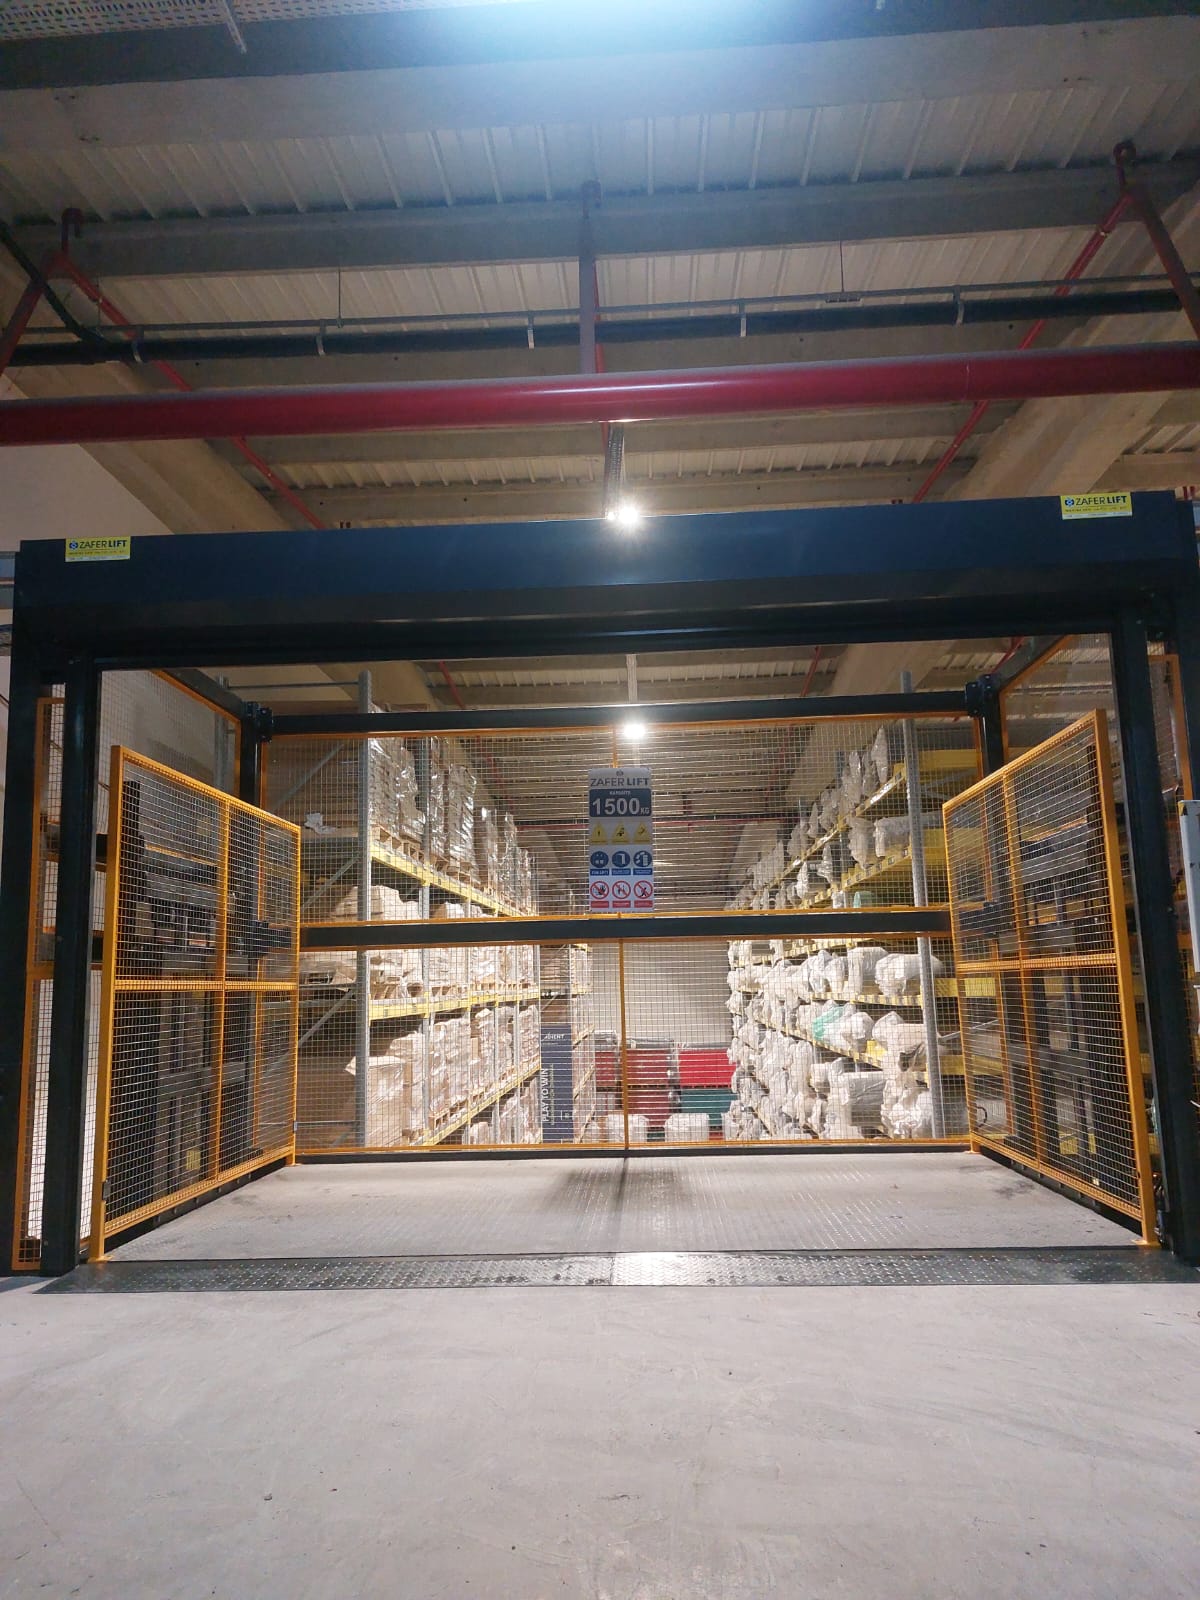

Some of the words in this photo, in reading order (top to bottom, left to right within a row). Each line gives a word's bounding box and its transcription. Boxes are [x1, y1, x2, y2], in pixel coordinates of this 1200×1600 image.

[591, 777, 625, 787] ZAFER
[627, 777, 649, 786] LIFT
[592, 798, 640, 815] 1500
[541, 1068, 549, 1087] WIN
[541, 1088, 549, 1100] TO
[541, 1102, 549, 1121] PLAY
